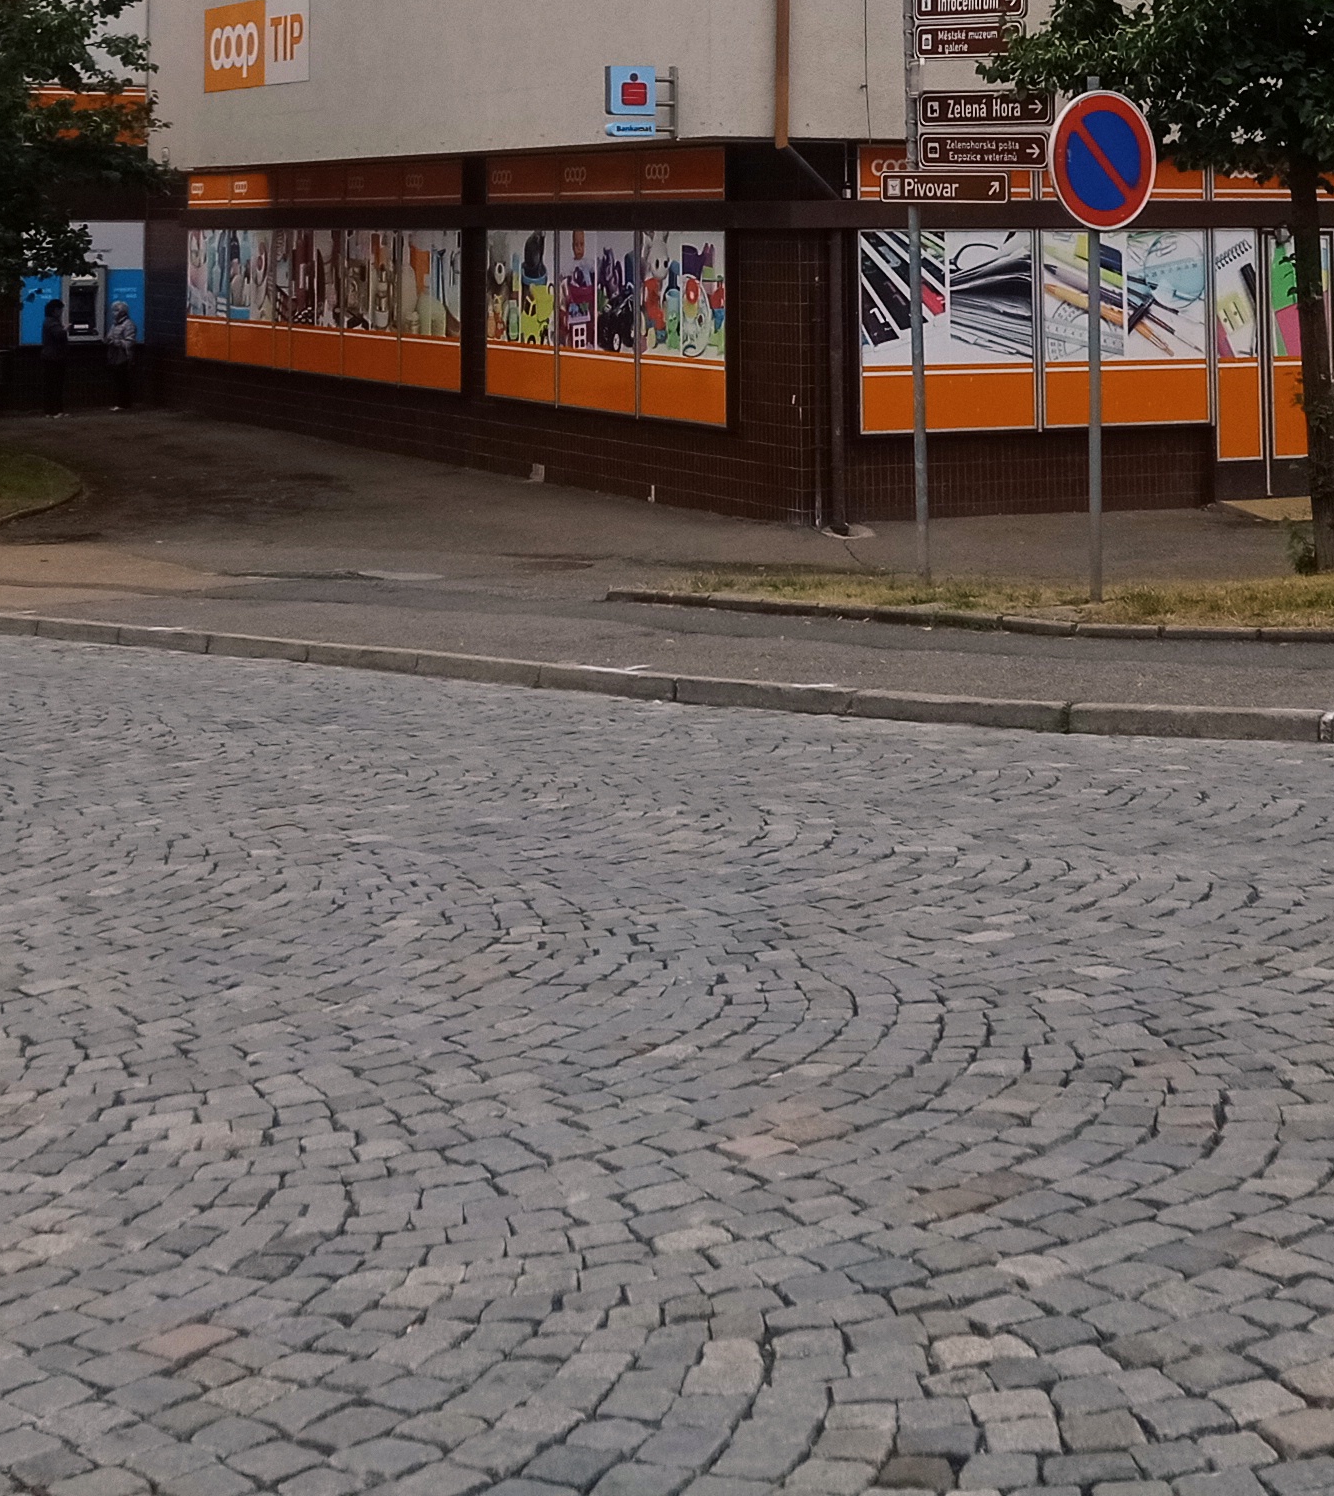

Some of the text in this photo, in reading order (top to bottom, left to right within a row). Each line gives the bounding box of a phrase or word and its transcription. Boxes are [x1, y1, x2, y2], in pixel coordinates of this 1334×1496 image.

[937, 29, 998, 40] Městské muzeum
[210, 12, 304, 78] coop TIP
[937, 42, 968, 55] a galerie
[947, 98, 1021, 118] Zelená Hora
[945, 139, 1020, 151] Zelenohorská pošta
[948, 150, 1018, 164] Expozice veteránů
[564, 166, 587, 185] coop
[646, 163, 669, 183] coop
[904, 178, 960, 198] Pivovar
